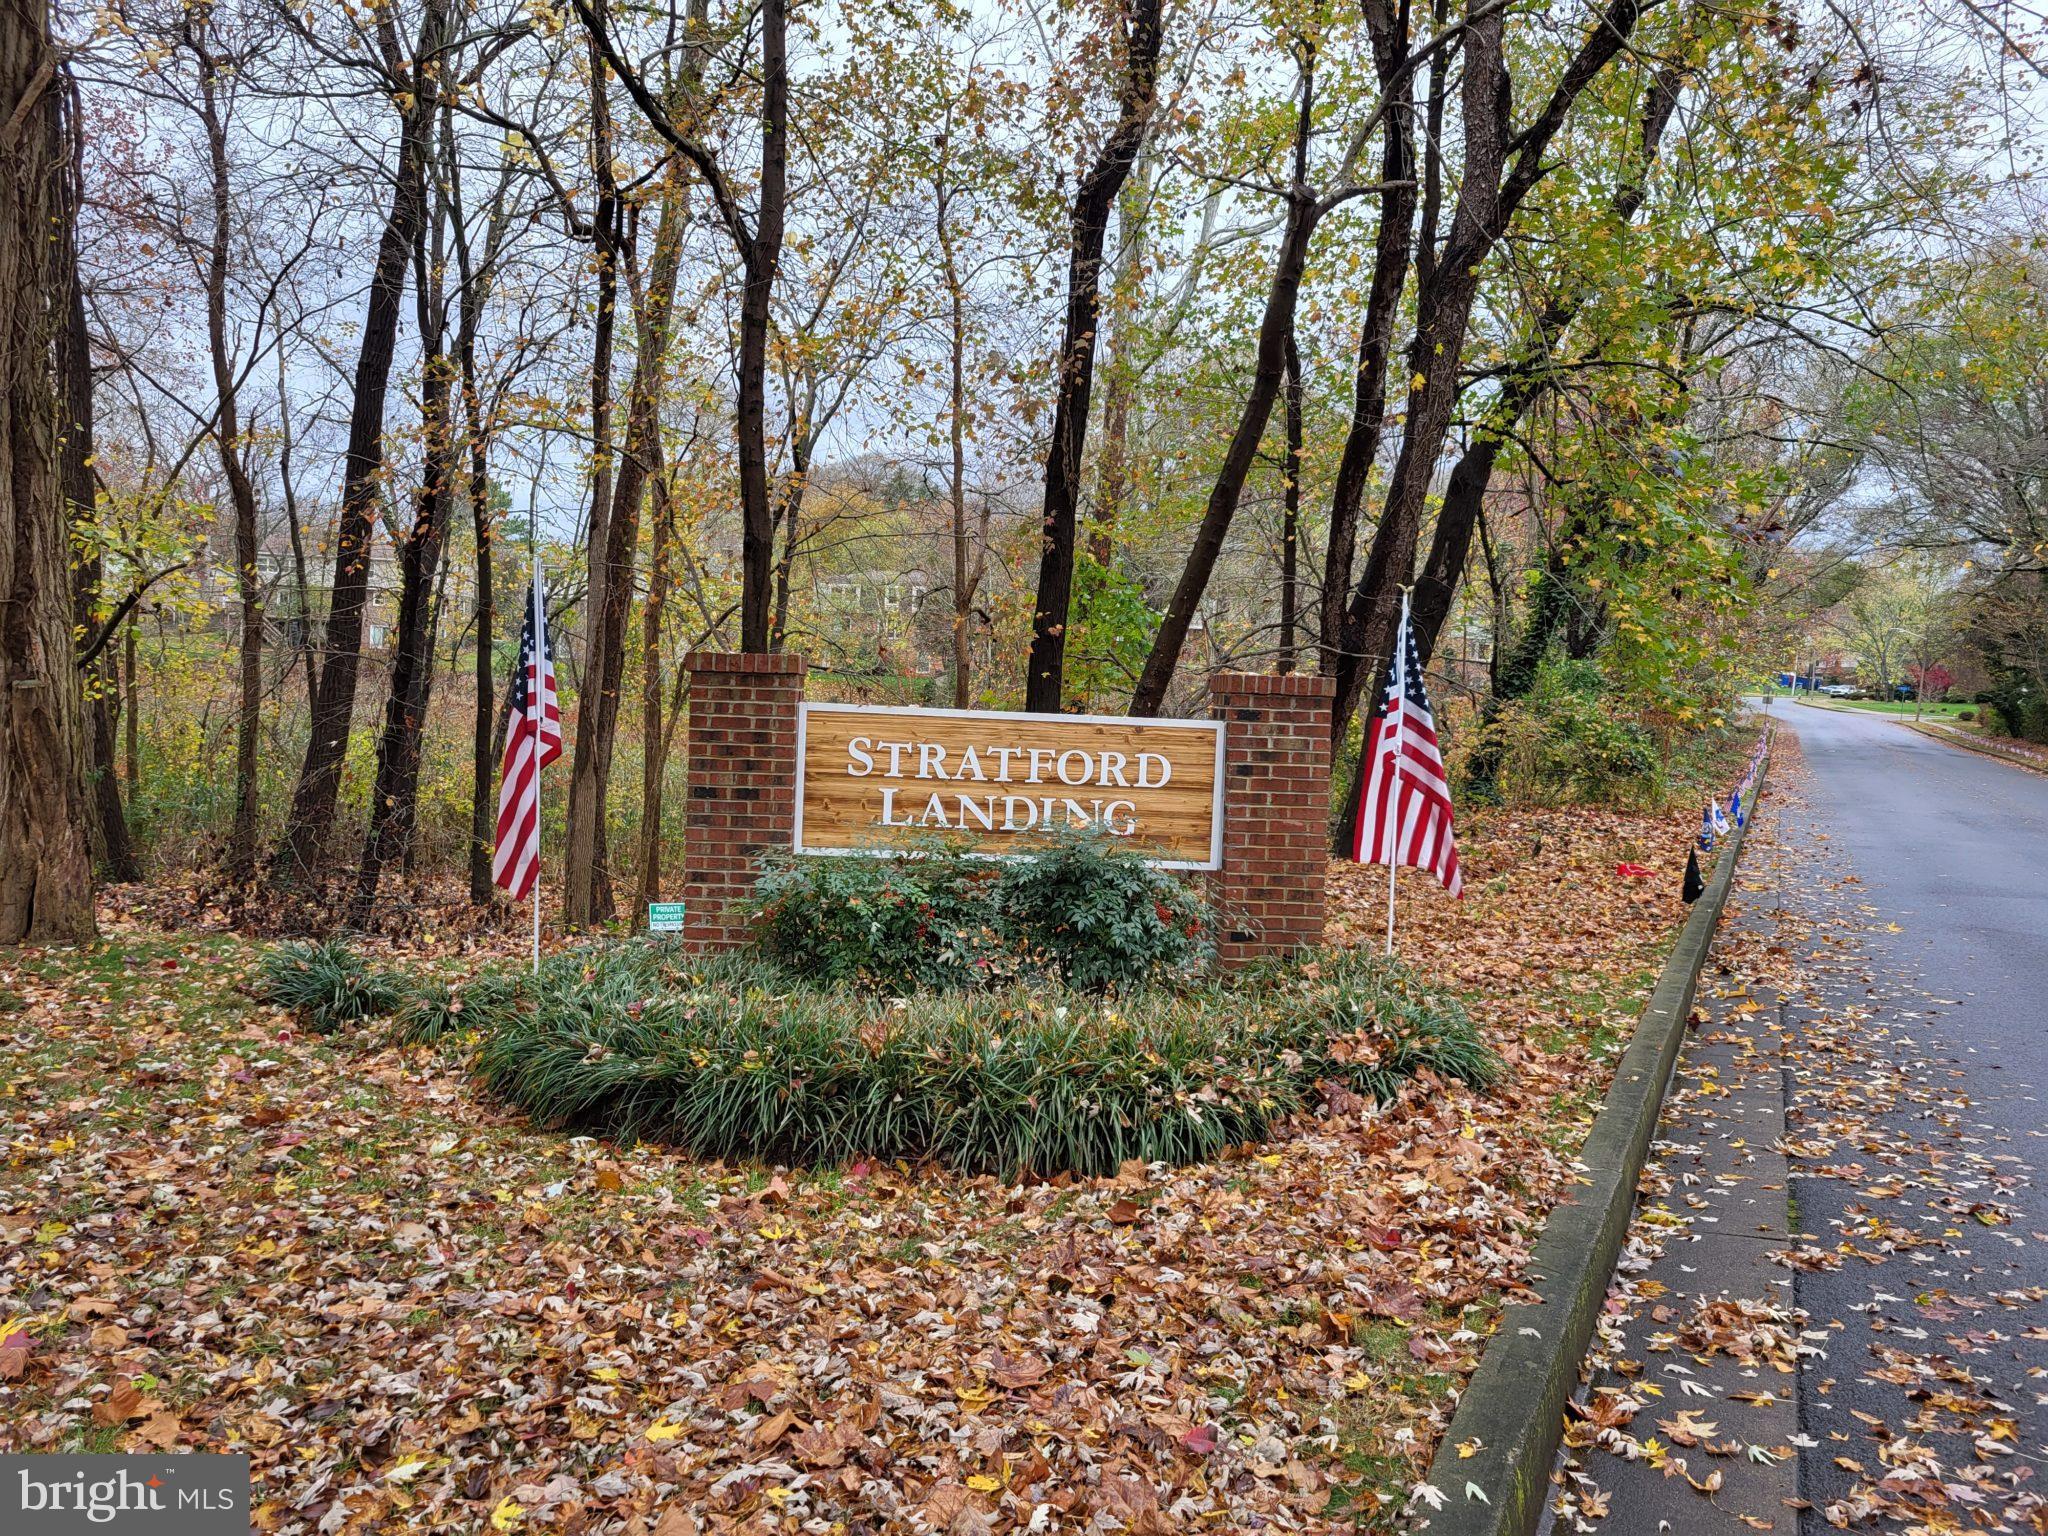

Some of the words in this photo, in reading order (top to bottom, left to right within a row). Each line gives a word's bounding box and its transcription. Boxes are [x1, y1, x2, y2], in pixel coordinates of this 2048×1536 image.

[847, 736, 1172, 788] STRATFORD
[877, 787, 1137, 837] LANDING
[652, 913, 684, 921] PROPERTY
[655, 905, 682, 913] PRIVATE
